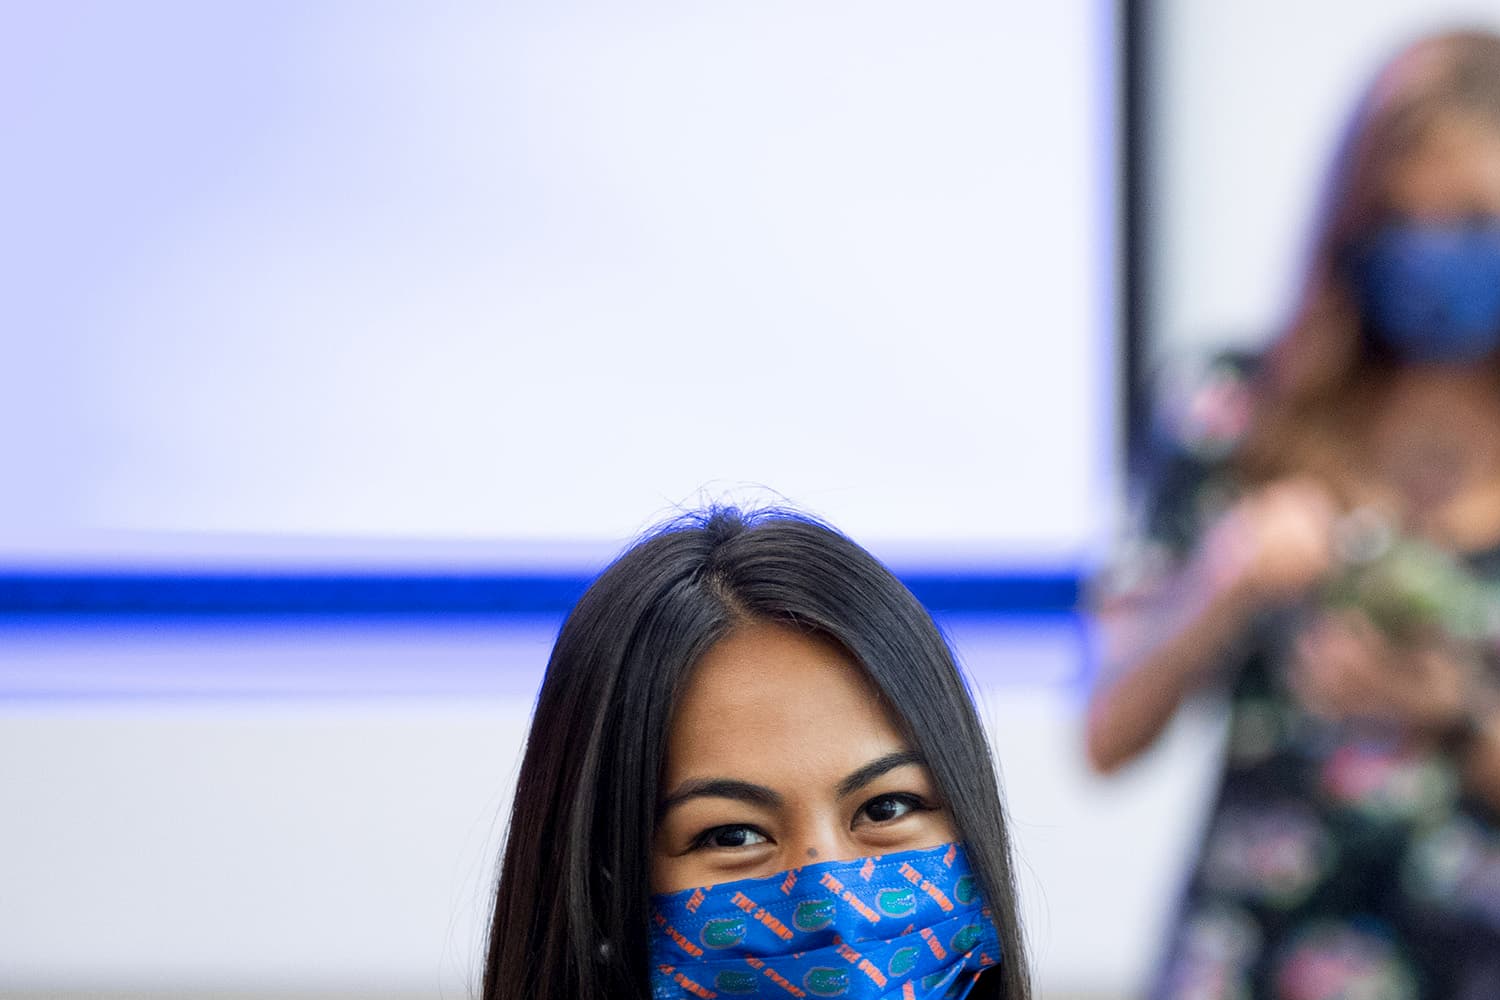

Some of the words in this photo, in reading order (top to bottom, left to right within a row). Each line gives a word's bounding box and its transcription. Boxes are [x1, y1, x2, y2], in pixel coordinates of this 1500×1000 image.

[820, 873, 845, 894] THE
[844, 892, 880, 922] SWAMP
[898, 863, 922, 887] THE
[921, 881, 954, 911] SWAMP
[731, 892, 757, 913] THE
[754, 909, 794, 940] SWAMP
